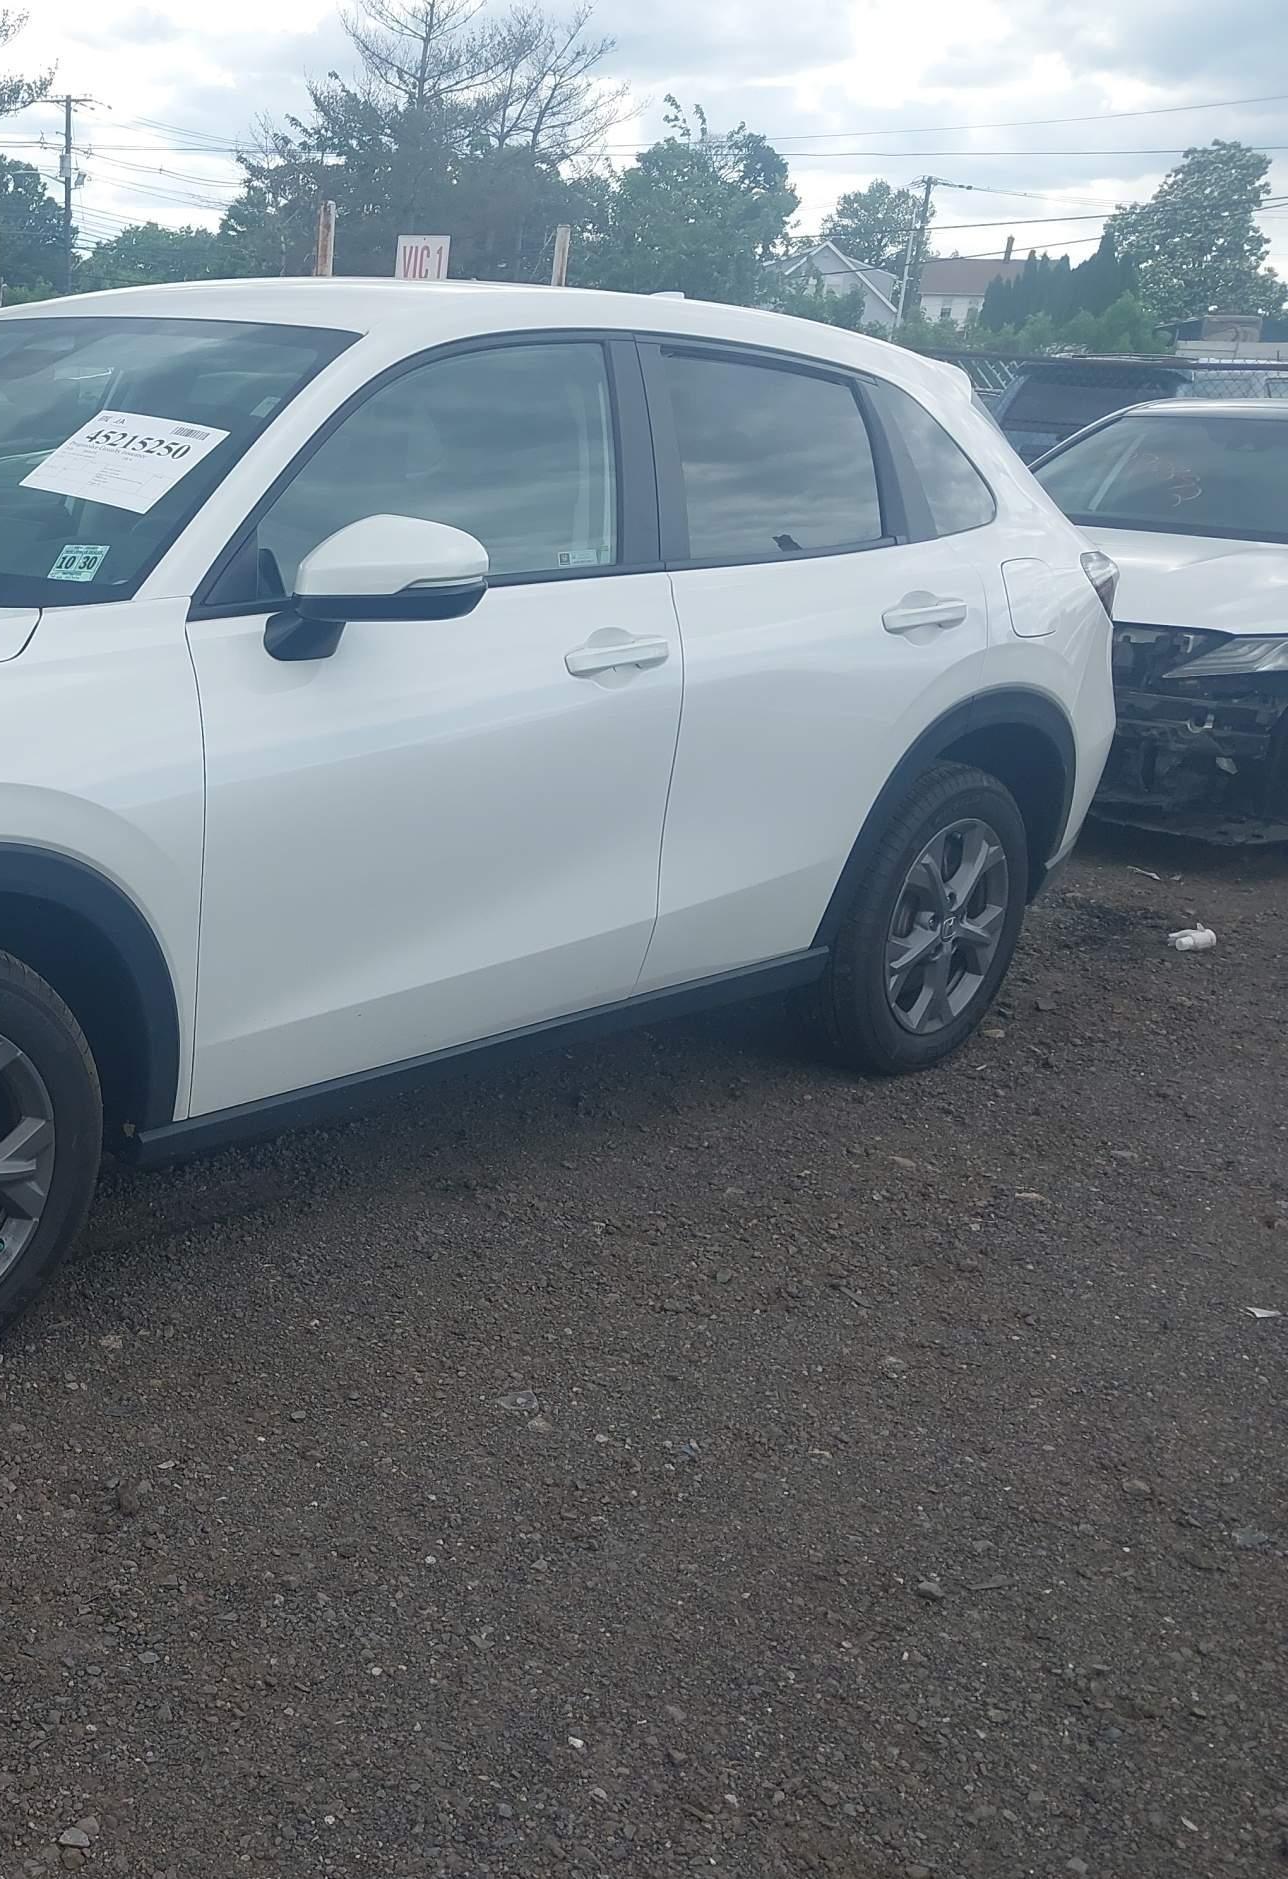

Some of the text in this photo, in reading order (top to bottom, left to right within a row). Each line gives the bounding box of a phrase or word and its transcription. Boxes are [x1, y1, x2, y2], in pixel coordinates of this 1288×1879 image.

[402, 245, 444, 279] VIC 1
[86, 429, 191, 459] 45215250
[56, 555, 98, 570] 10 30
